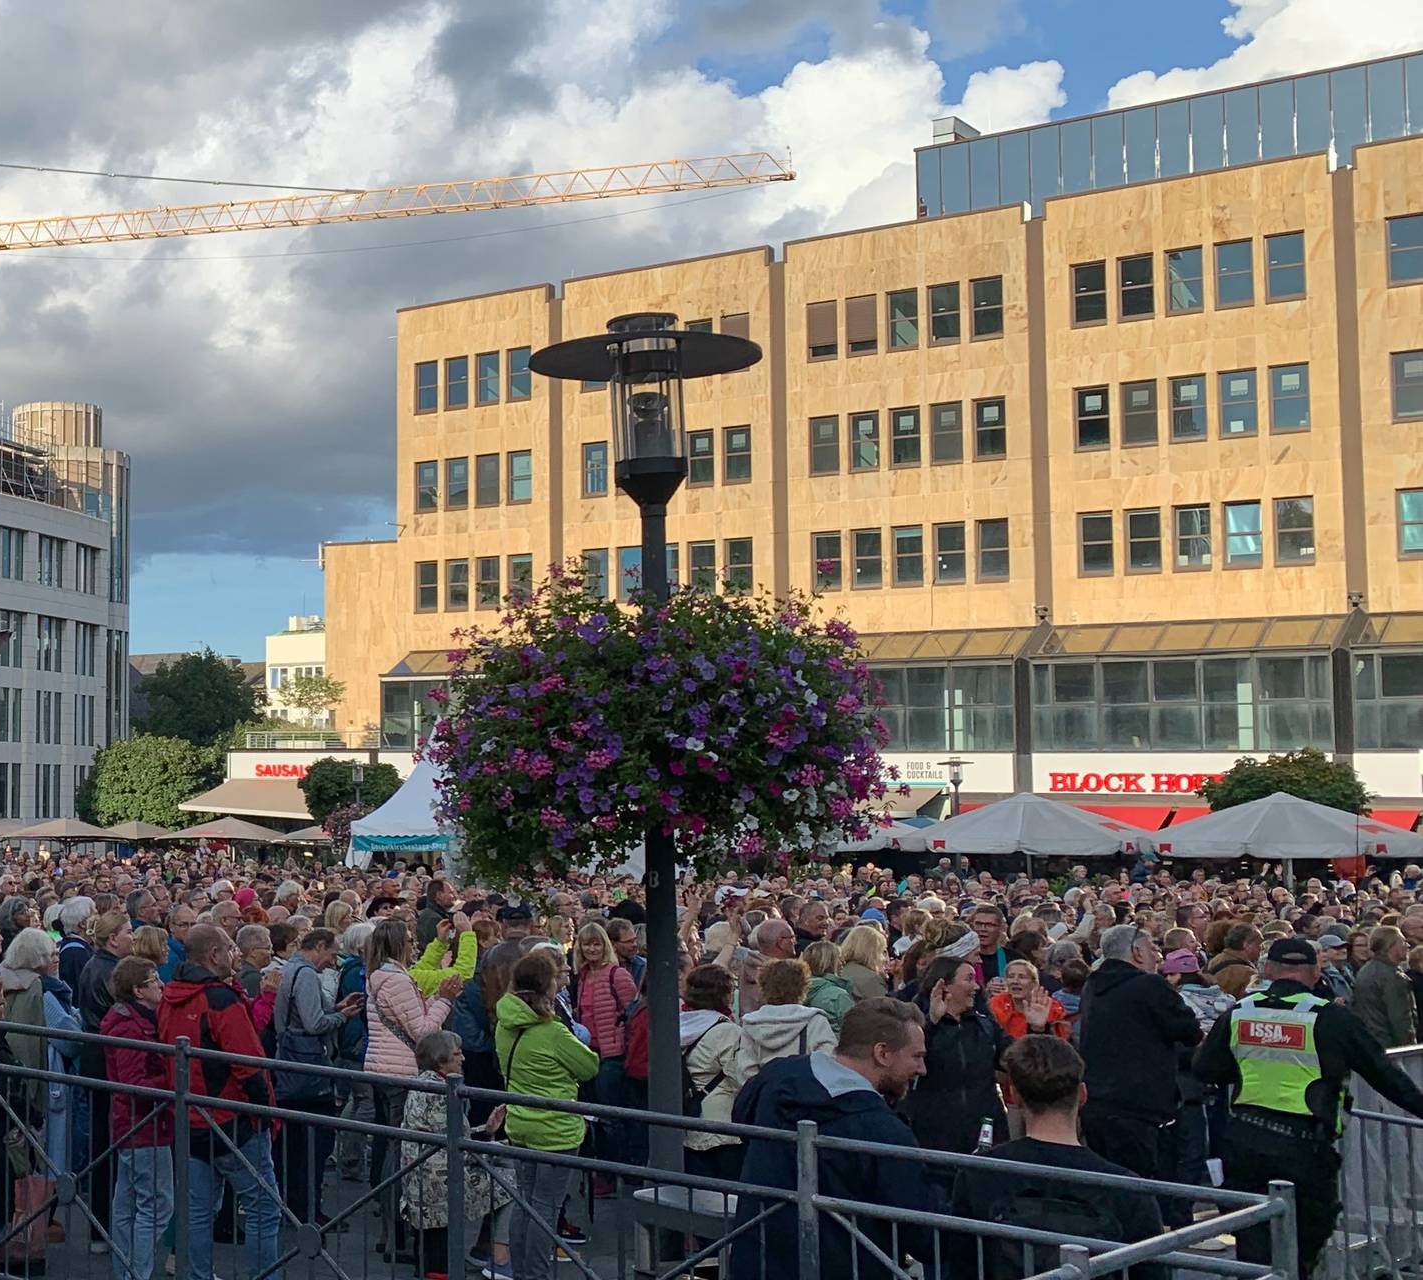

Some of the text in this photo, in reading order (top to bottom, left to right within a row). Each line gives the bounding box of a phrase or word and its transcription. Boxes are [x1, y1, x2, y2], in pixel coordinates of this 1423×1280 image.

[255, 764, 306, 777] SAUSAL
[906, 761, 931, 770] FOOD &
[906, 770, 943, 779] COCKTAILS
[1049, 773, 1146, 792] BLOCK
[1249, 1021, 1283, 1039] ISSA
